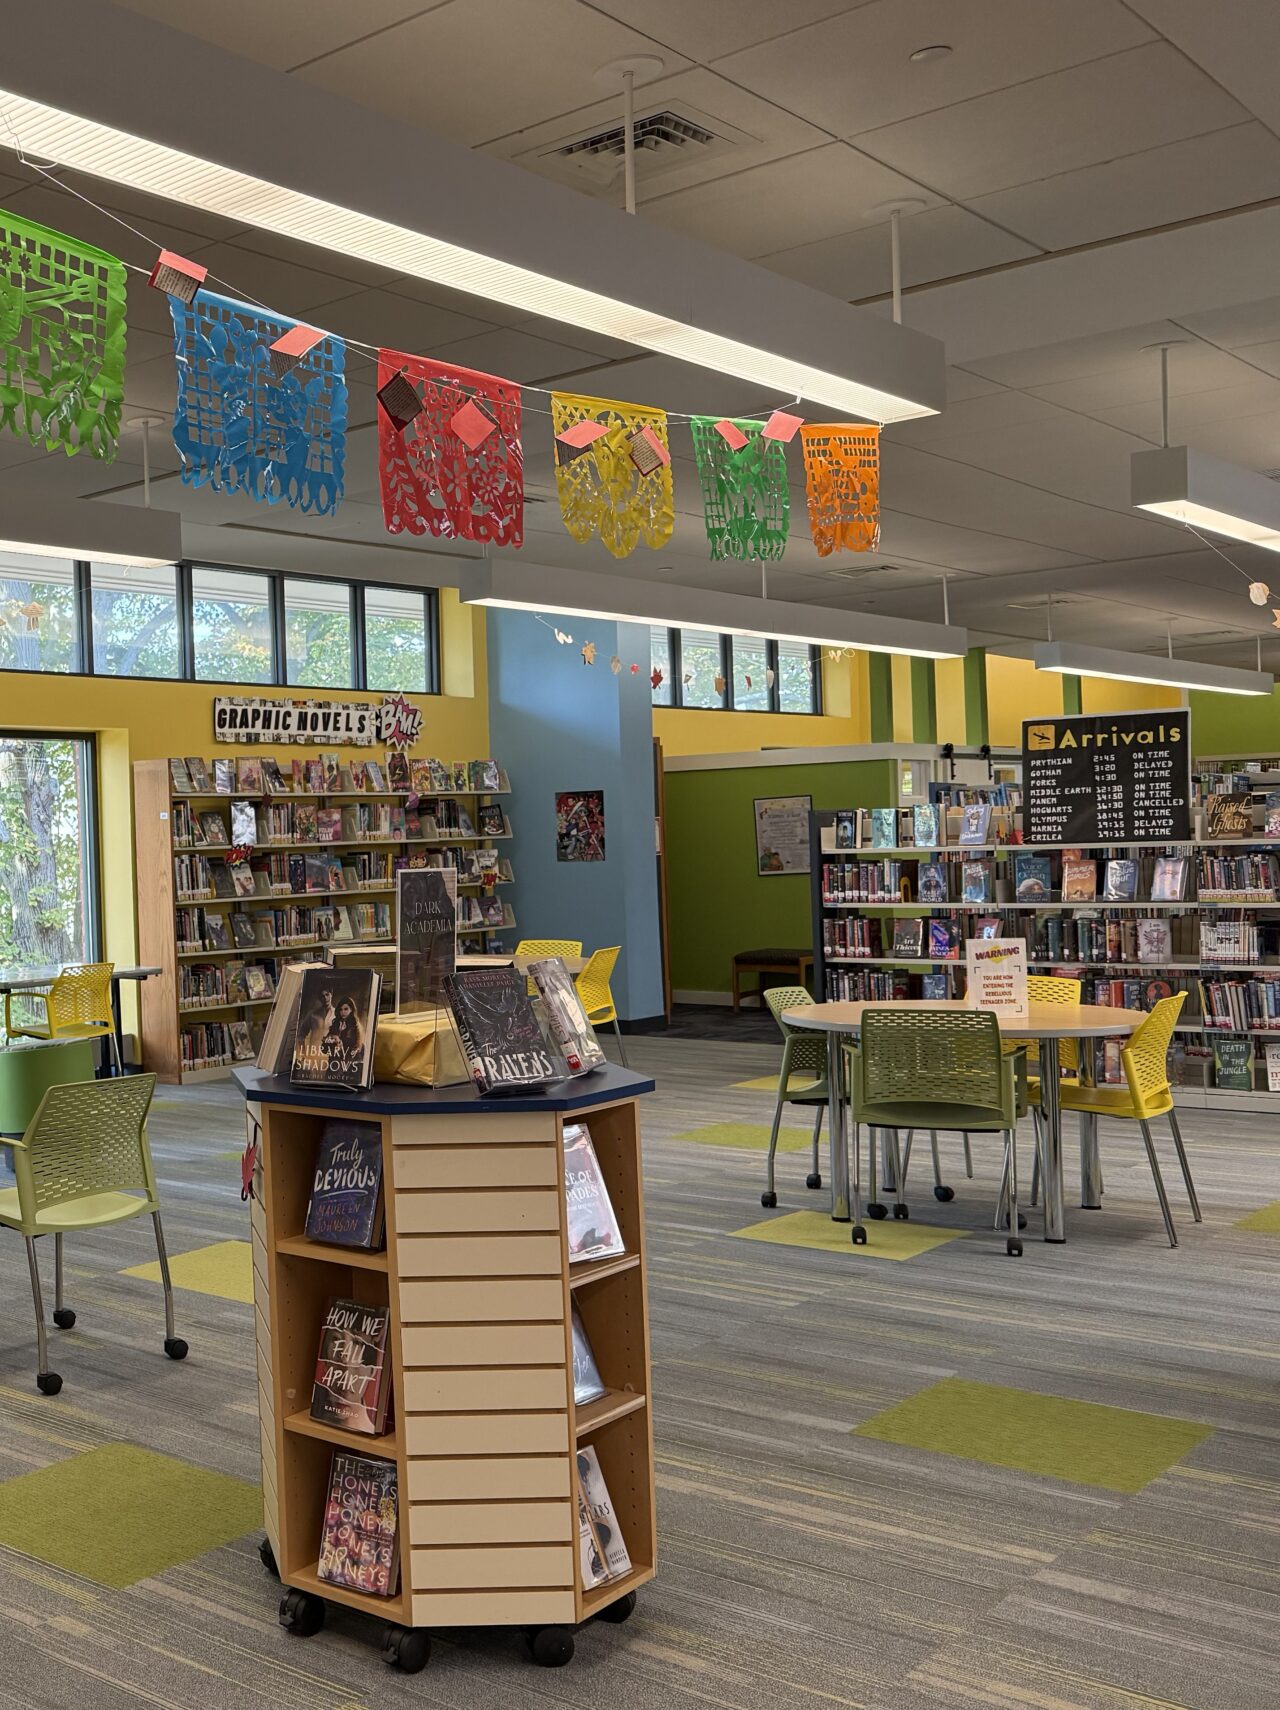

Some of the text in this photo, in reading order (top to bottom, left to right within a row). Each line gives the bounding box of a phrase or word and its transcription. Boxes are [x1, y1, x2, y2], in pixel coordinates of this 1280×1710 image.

[216, 708, 367, 734] GRAPHIC NOVELS
[379, 703, 423, 740] BAM!
[1058, 725, 1181, 749] Arrivals
[1031, 758, 1072, 767] PRYTHIAN
[1093, 754, 1115, 762] 2:45
[1133, 752, 1144, 760] ON
[1031, 760, 1173, 777] GOTHAM 3:20 DELAYED
[1134, 771, 1144, 779] ON
[1030, 788, 1061, 796] MIDDLE
[1065, 786, 1091, 795] EARTH
[1096, 785, 1123, 793] 12:30
[1149, 782, 1172, 790] TIME
[1097, 793, 1123, 801] 14:50
[1211, 795, 1252, 813] Raised
[1031, 799, 1184, 814] HOGWARTS 16:30 CANCELLED
[1097, 812, 1124, 820] 18:45
[1148, 808, 1171, 816] TIME
[1097, 821, 1124, 829] 19:15
[1134, 819, 1174, 827] DELAYED
[1210, 813, 1248, 837] Ghosts
[1031, 827, 1172, 841] ERILEA 19:15 ON TIME
[416, 901, 441, 914] DARK
[405, 919, 452, 934] ACADEMIA
[975, 947, 1019, 960] WARNING
[300, 1044, 360, 1060] LIBRARY of
[481, 1043, 497, 1055] The
[1221, 1044, 1245, 1052] DEATH
[296, 1058, 358, 1072] SHADOWS
[484, 1051, 553, 1081] RAVENS
[1219, 1066, 1247, 1075] JUNGLE
[330, 1138, 364, 1169] Truly
[314, 1166, 377, 1192] DEVIOUS
[317, 1204, 360, 1217] MAUREEN
[314, 1220, 358, 1233] JOHNSON
[326, 1307, 385, 1336] HOW WE
[333, 1340, 365, 1363] FALL
[322, 1366, 376, 1394] APART
[324, 1405, 341, 1414] KATIE
[335, 1457, 366, 1477] THE
[332, 1472, 397, 1500] HONEYS
[328, 1506, 393, 1535] HONEYS
[326, 1525, 390, 1565] HONEYS
[323, 1546, 386, 1586] HONEYS
